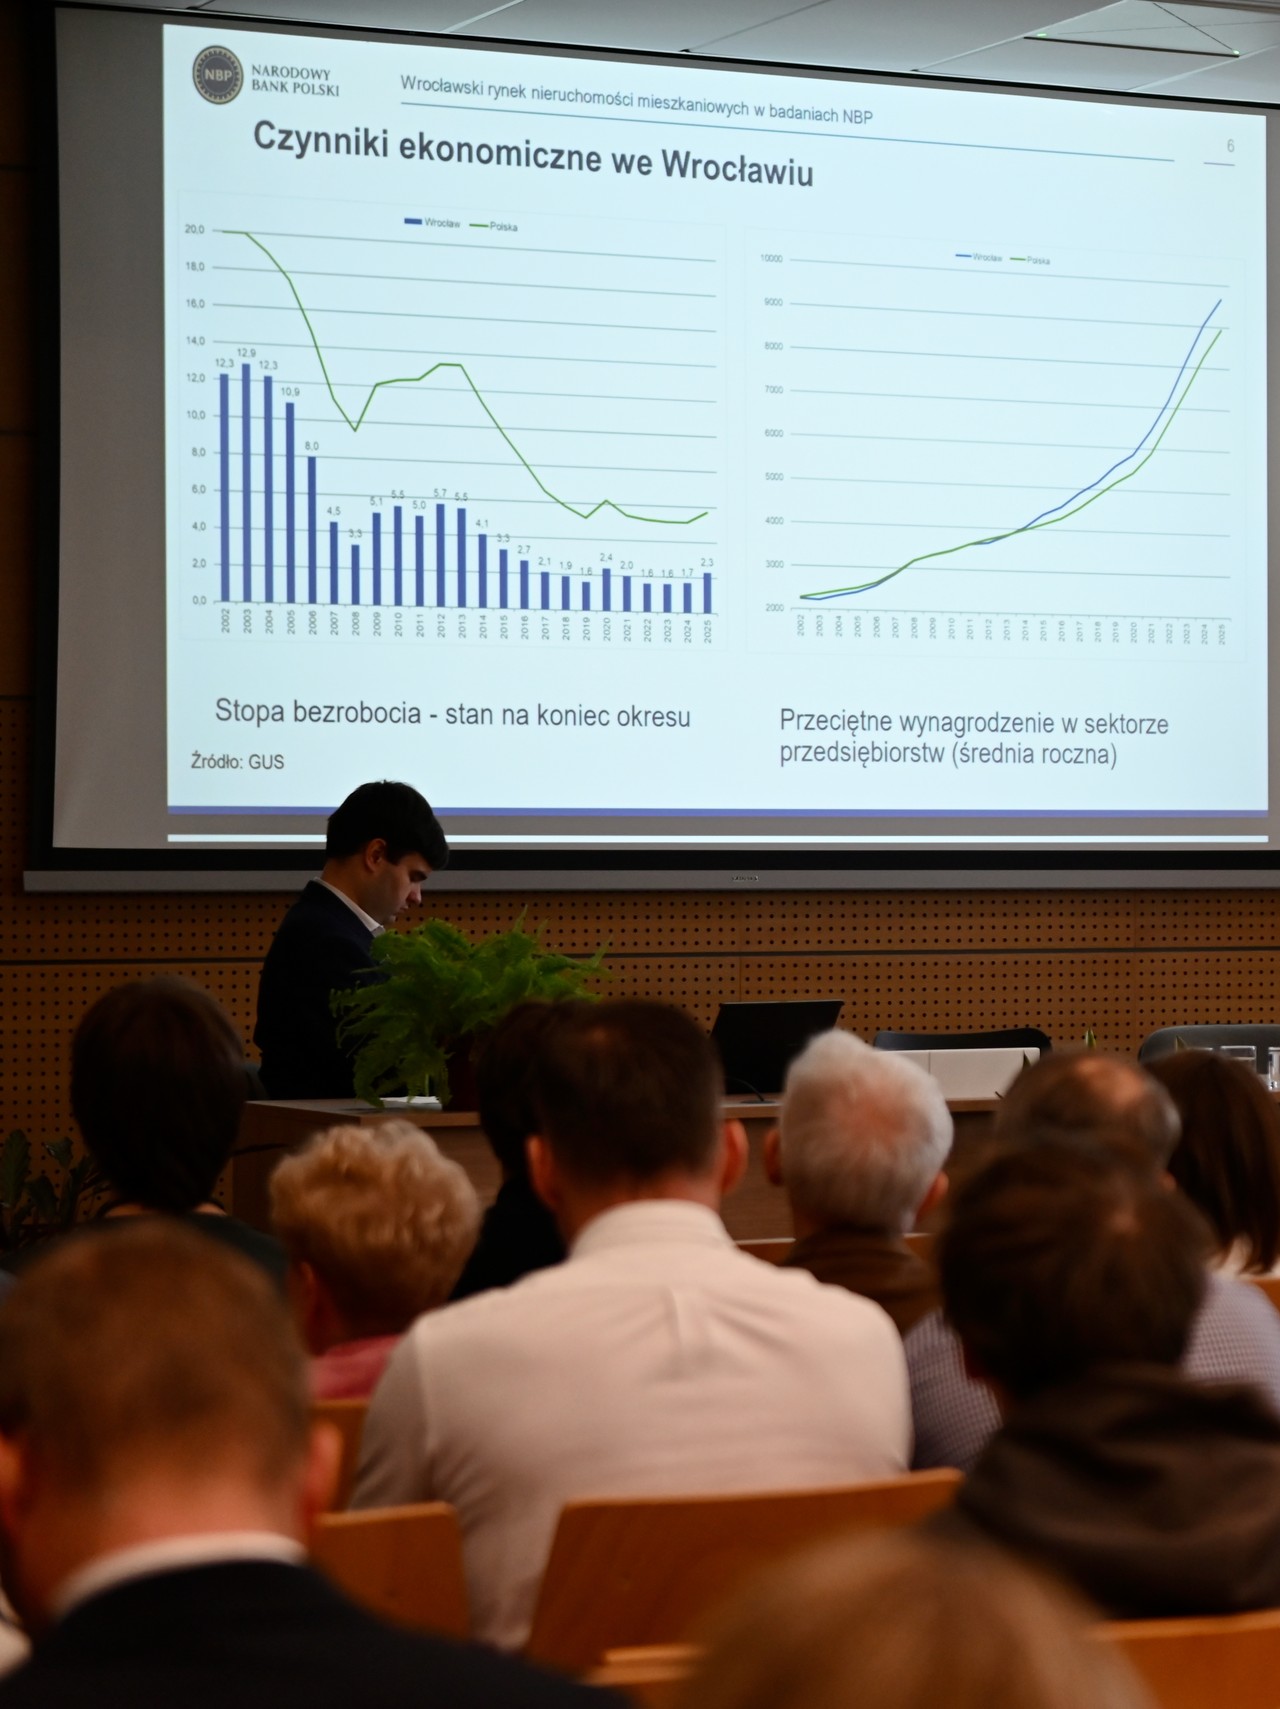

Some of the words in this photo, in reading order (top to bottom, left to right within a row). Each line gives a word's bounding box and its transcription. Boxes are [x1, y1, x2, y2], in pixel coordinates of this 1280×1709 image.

[205, 69, 232, 81] NBP
[252, 64, 331, 81] NARODOWY
[252, 79, 289, 93] BANK
[293, 82, 340, 97] POLSKI
[400, 73, 484, 95] Wrocławski
[487, 82, 527, 102] rynek
[530, 83, 634, 107] nieruchomości
[637, 93, 750, 118] mieszkaniowych
[754, 106, 766, 117] w
[769, 104, 839, 123] badaniach
[843, 109, 873, 125] NBP
[254, 119, 389, 159] Czynniki
[399, 133, 602, 171] ekonomiczne
[611, 152, 652, 175] we
[662, 149, 814, 187] Wrocławiu
[1227, 139, 1235, 153] 6
[490, 221, 518, 232] Polska
[1027, 256, 1050, 265] Polska
[222, 609, 230, 633] 2002
[243, 610, 252, 633] 2003
[265, 610, 274, 634] 2004
[287, 610, 295, 634] 2005
[309, 611, 317, 635] 2006
[352, 612, 360, 636] 2008
[373, 612, 381, 636] 2009
[395, 613, 403, 636] 2010
[416, 613, 424, 637] 2011
[437, 614, 445, 638] 2012
[458, 615, 466, 638] 2013
[479, 615, 487, 639] 2014
[500, 616, 508, 639] 2015
[521, 616, 529, 640] 2016
[562, 617, 570, 641] 2018
[582, 618, 590, 641] 2019
[603, 618, 611, 642] 2020
[623, 619, 631, 643] 2021
[643, 619, 651, 643] 2022
[684, 620, 692, 643] 2024
[704, 620, 712, 644] 2025
[215, 698, 286, 727] Stopa
[293, 699, 422, 725] bezrobocia
[445, 703, 493, 726] stan
[501, 708, 529, 727] na
[537, 703, 610, 727] koniec
[617, 704, 691, 728] okresu
[780, 707, 893, 735] Przeciętne
[900, 710, 1055, 738] wynagrodzenie
[1062, 718, 1078, 734] w
[1085, 713, 1169, 735] sektorze
[190, 750, 243, 770] Źródło:
[248, 753, 285, 770] GUS
[779, 740, 945, 767] przedsiębiorstw
[952, 741, 1035, 769] (średnia
[1041, 743, 1118, 770] roczna)
